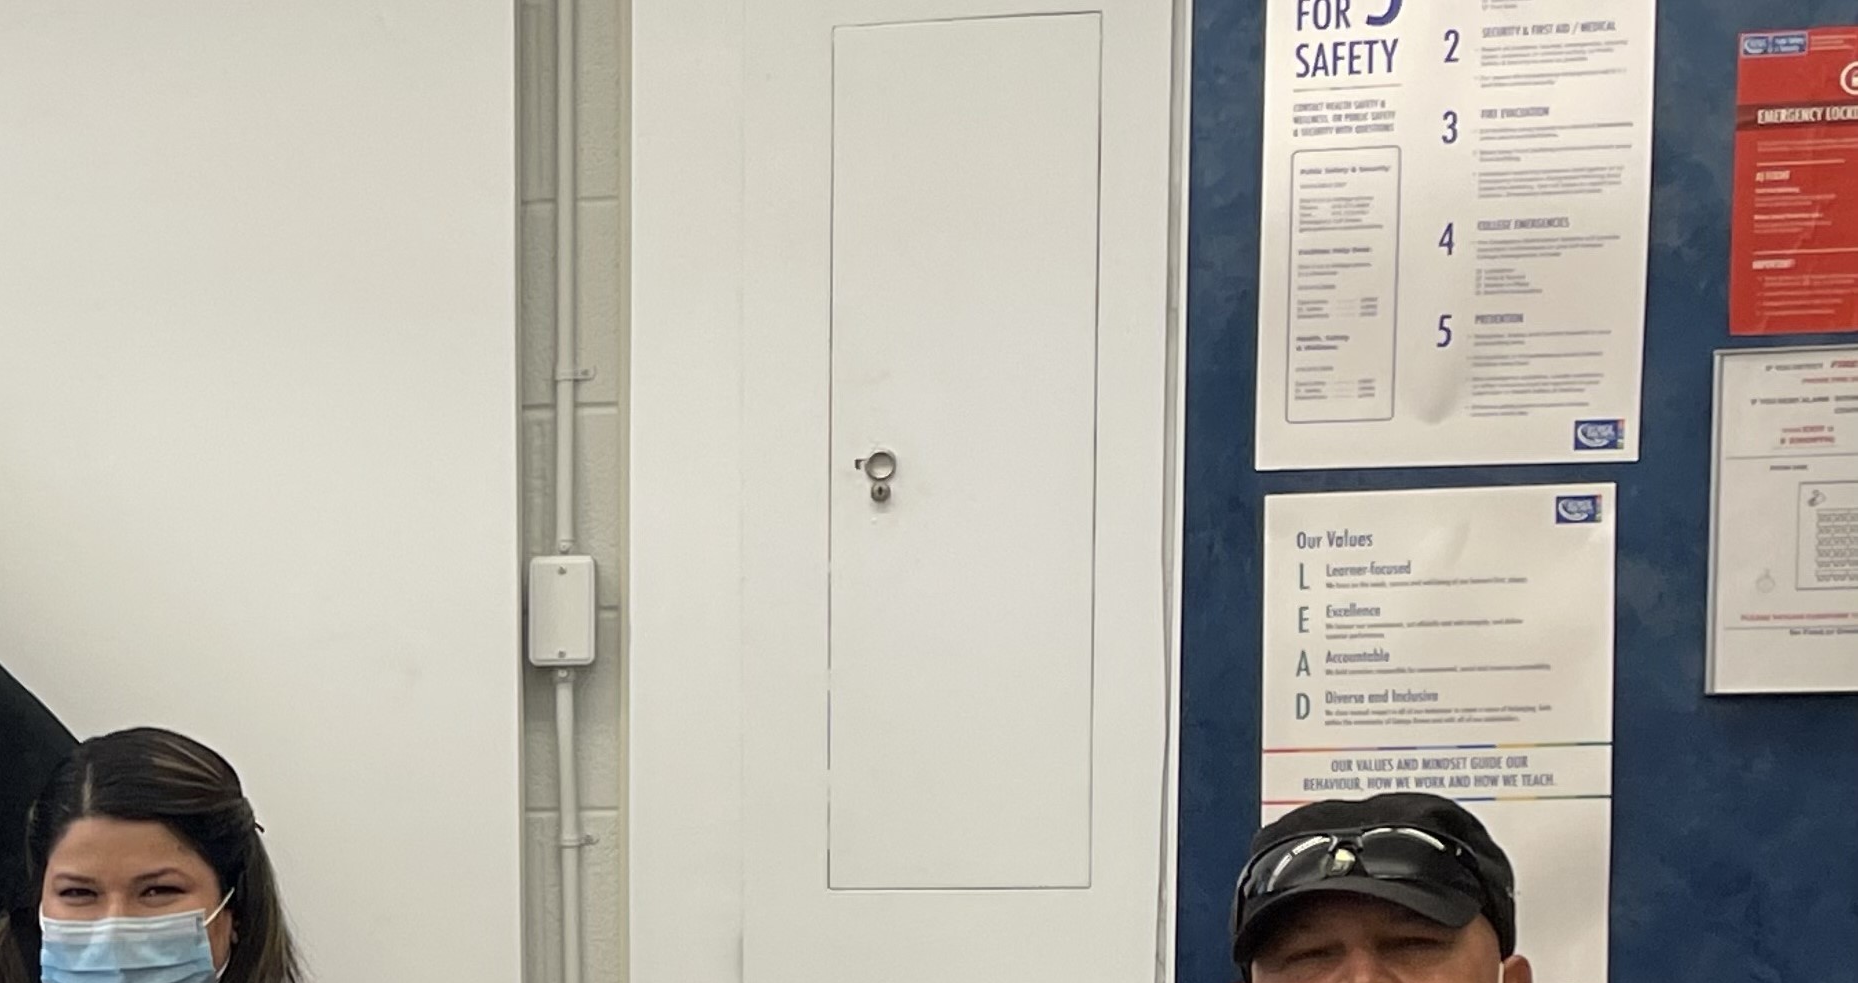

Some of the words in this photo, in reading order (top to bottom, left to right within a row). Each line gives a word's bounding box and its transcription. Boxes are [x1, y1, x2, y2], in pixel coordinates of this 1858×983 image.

[1297, 0, 1350, 31] FOR
[1295, 38, 1399, 78] SAFETY
[1443, 29, 1460, 63] 2
[1442, 110, 1458, 145] 3
[1757, 107, 1823, 124] EMERGENCY
[1438, 222, 1455, 256] 4
[1437, 314, 1453, 348] 5
[1296, 531, 1322, 550] Our
[1326, 528, 1373, 548] Values
[1299, 562, 1310, 590] L
[1326, 560, 1411, 577] Learner-focused
[1298, 606, 1309, 633] E
[1326, 603, 1381, 618] Excellence
[1296, 650, 1311, 677] A
[1326, 647, 1390, 663] Accountable
[1295, 692, 1311, 720] D
[1325, 690, 1364, 704] Diverse
[1368, 689, 1388, 703] and
[1392, 689, 1438, 703] Inclusive
[1331, 759, 1353, 772] OUR
[1356, 758, 1393, 771] VALUES
[1397, 758, 1419, 771] AND
[1422, 757, 1467, 770] MINDSET
[1470, 756, 1503, 769] GUIDE
[1506, 755, 1529, 768] OUR
[1367, 777, 1393, 789] HOW
[1396, 776, 1410, 789] WE
[1414, 776, 1446, 788] WORK
[1448, 775, 1471, 787] AND
[1474, 774, 1499, 787] HOW
[1502, 774, 1518, 786] WE
